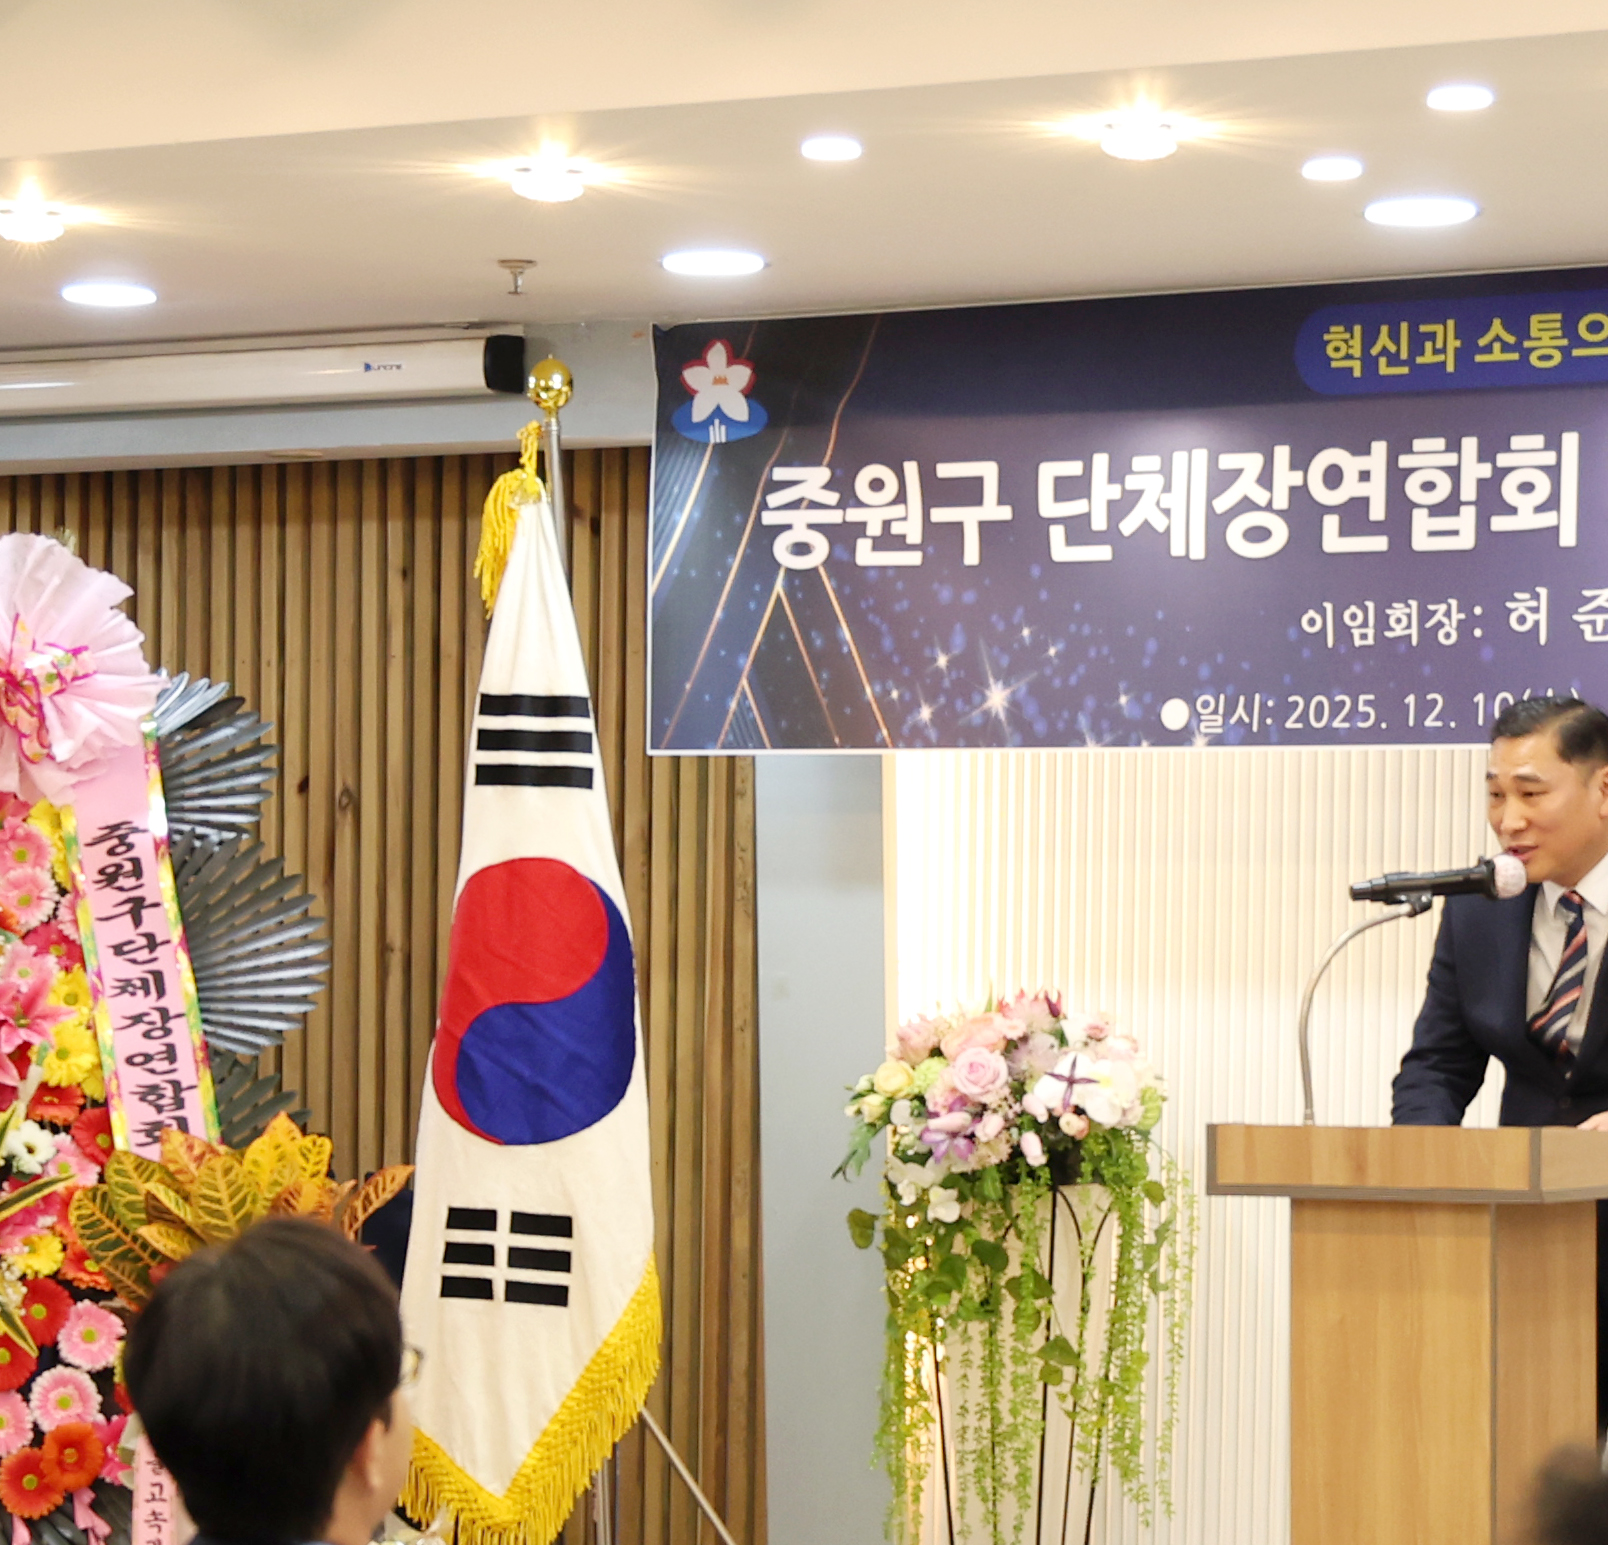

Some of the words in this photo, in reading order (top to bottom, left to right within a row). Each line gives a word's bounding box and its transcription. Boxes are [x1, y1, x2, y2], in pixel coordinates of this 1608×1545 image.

[1323, 319, 1462, 376] 혁신과
[761, 461, 1013, 570] 중원구
[1037, 431, 1580, 562] 단체장연합회
[1299, 598, 1483, 649] 이임회장:
[1284, 692, 1388, 731] 2025.
[1404, 691, 1456, 730] 12.
